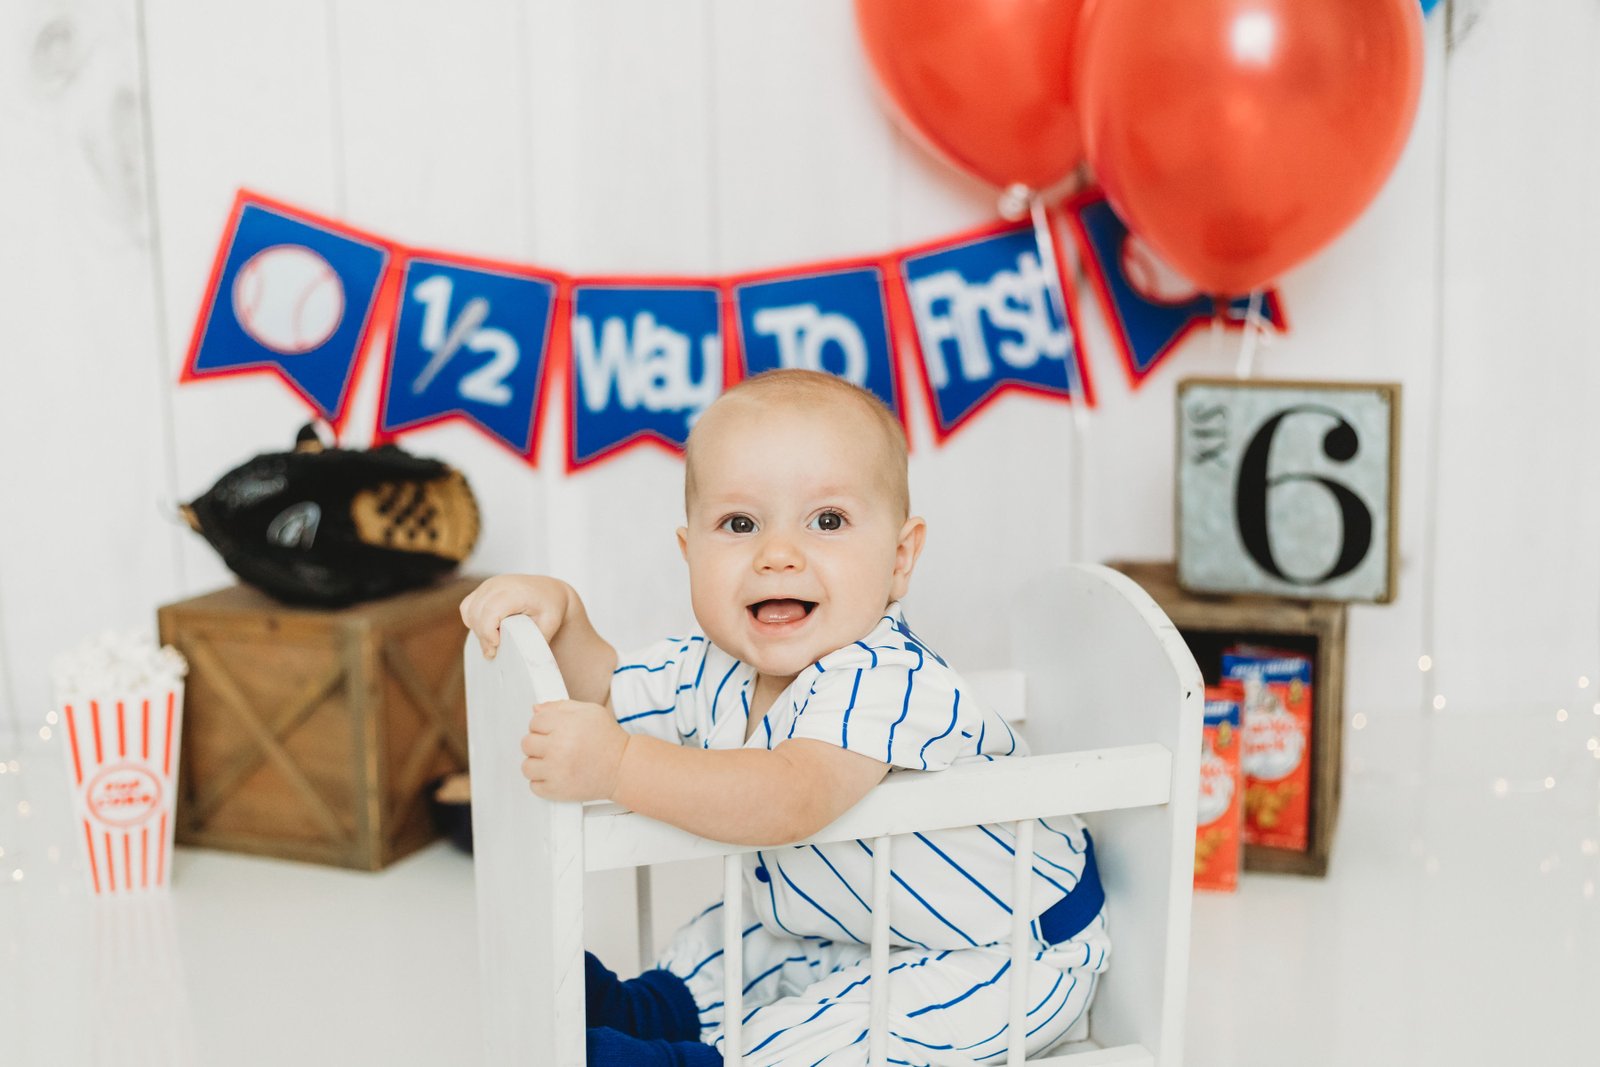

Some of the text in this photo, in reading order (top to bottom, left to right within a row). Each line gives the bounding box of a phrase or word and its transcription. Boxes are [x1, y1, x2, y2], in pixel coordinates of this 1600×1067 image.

[571, 311, 723, 430] Way
[1188, 402, 1229, 467] SIX
[1235, 402, 1374, 587] 6
